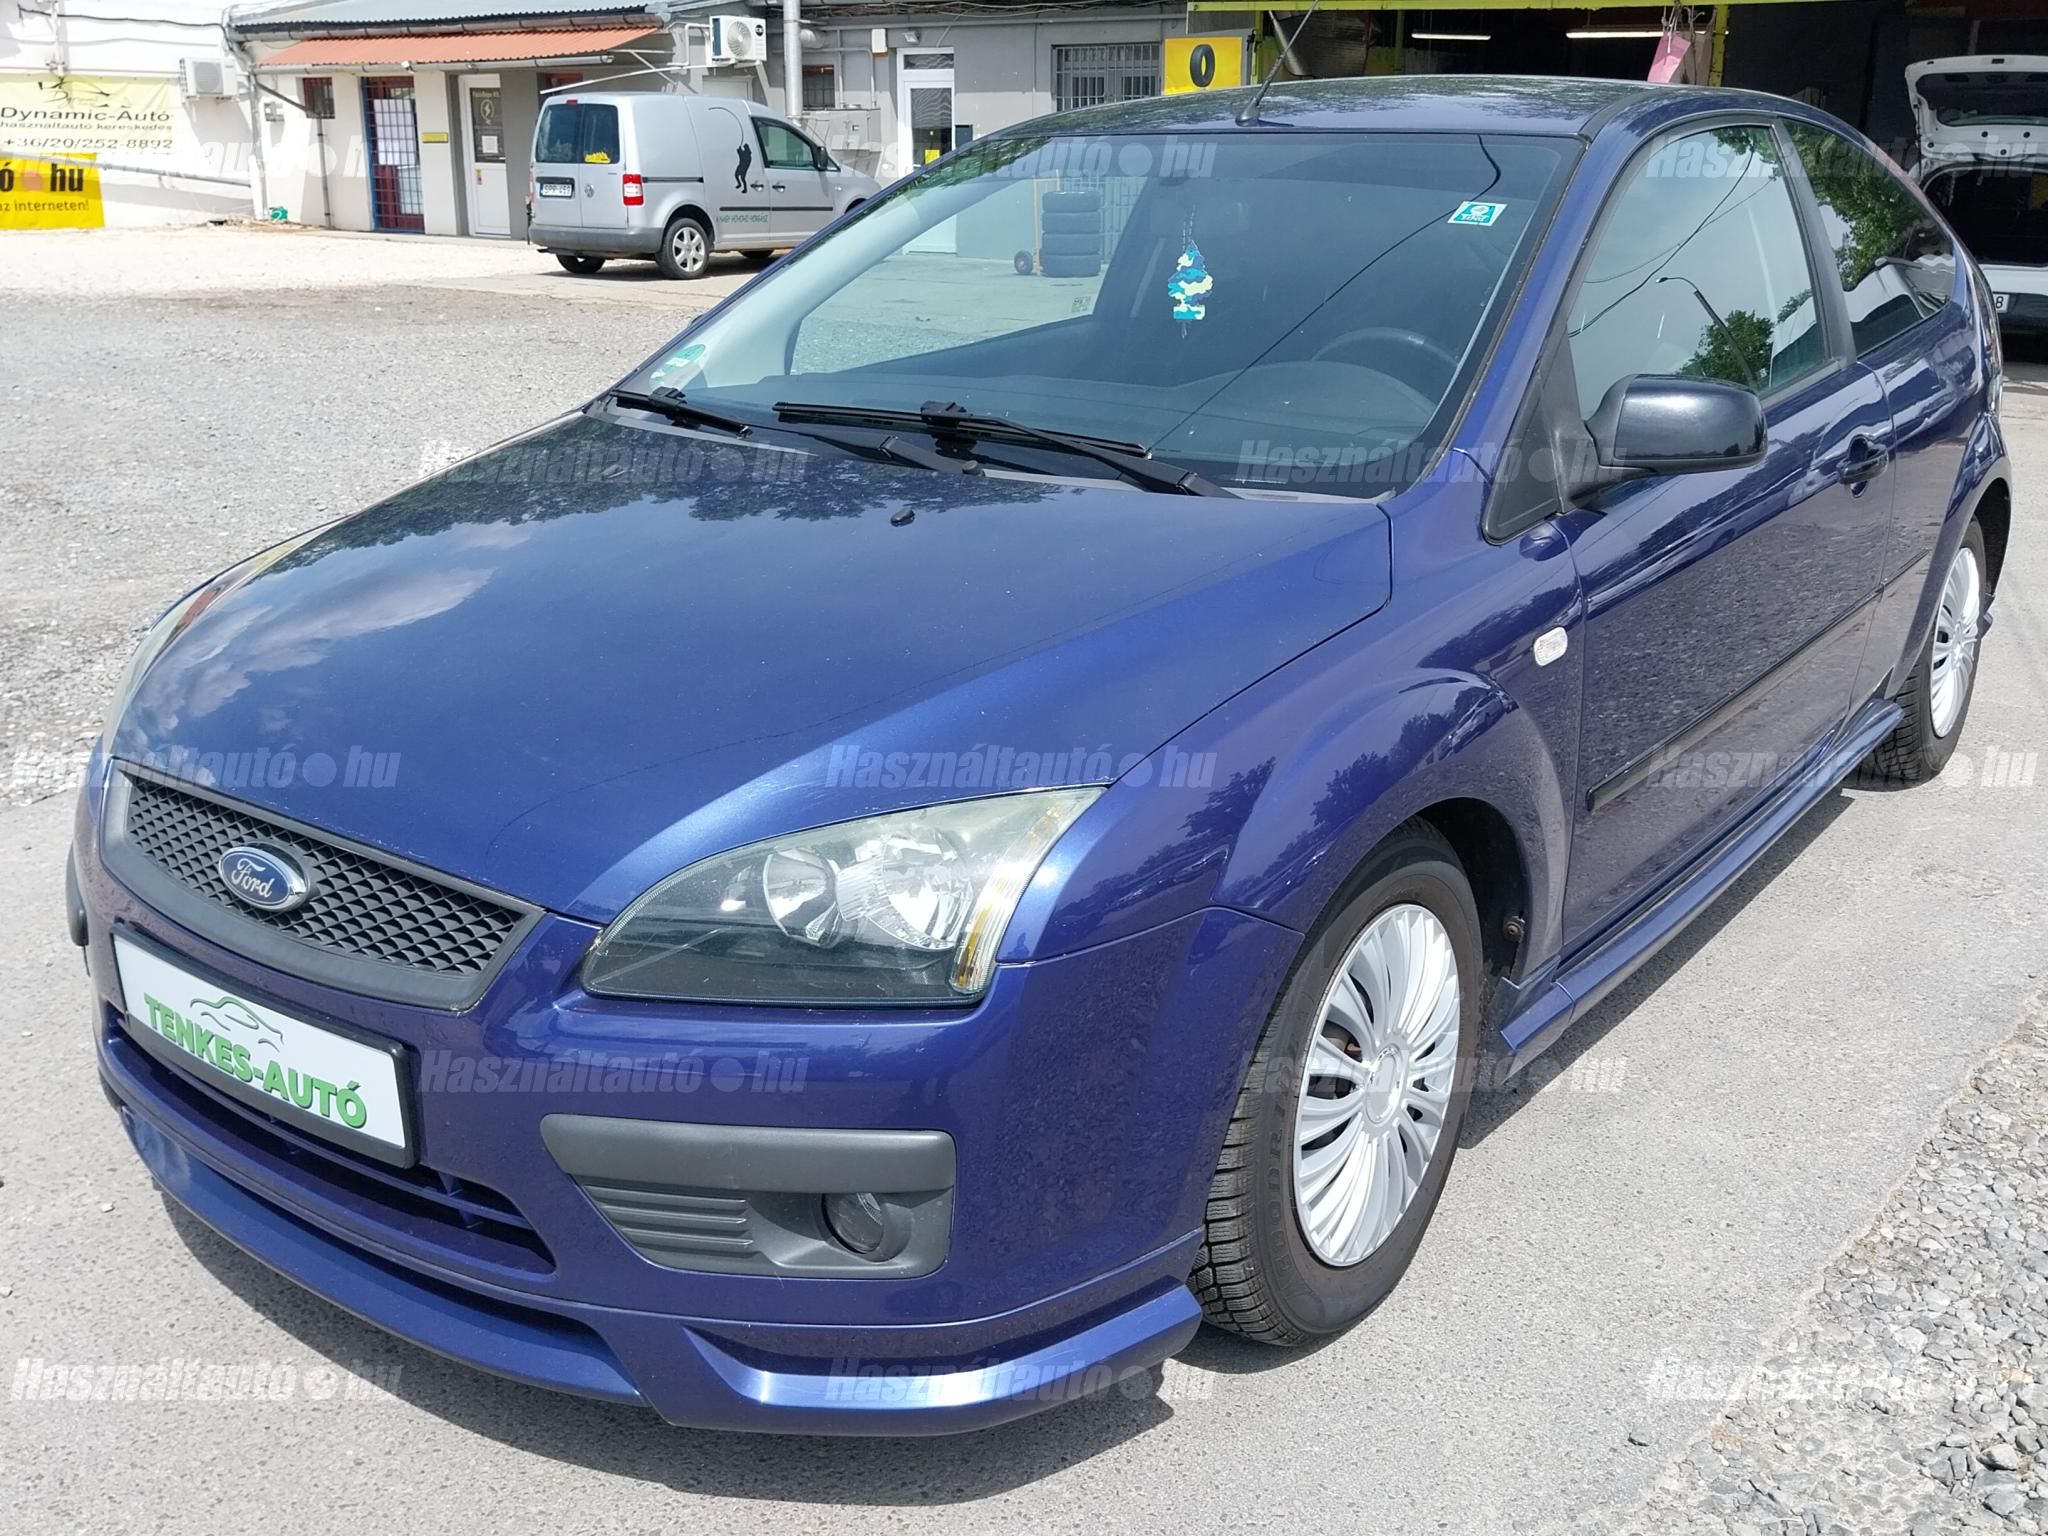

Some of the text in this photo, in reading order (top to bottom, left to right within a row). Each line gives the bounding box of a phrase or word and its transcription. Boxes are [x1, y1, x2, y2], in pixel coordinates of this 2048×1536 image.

[1, 107, 170, 121] Dynamic-Autó
[3, 138, 173, 150] +36/20/252-8892
[50, 162, 83, 192] hu
[14, 199, 90, 212] interneten!
[231, 858, 276, 898] Ford
[143, 992, 368, 1129] TENKES-AUTÓ
